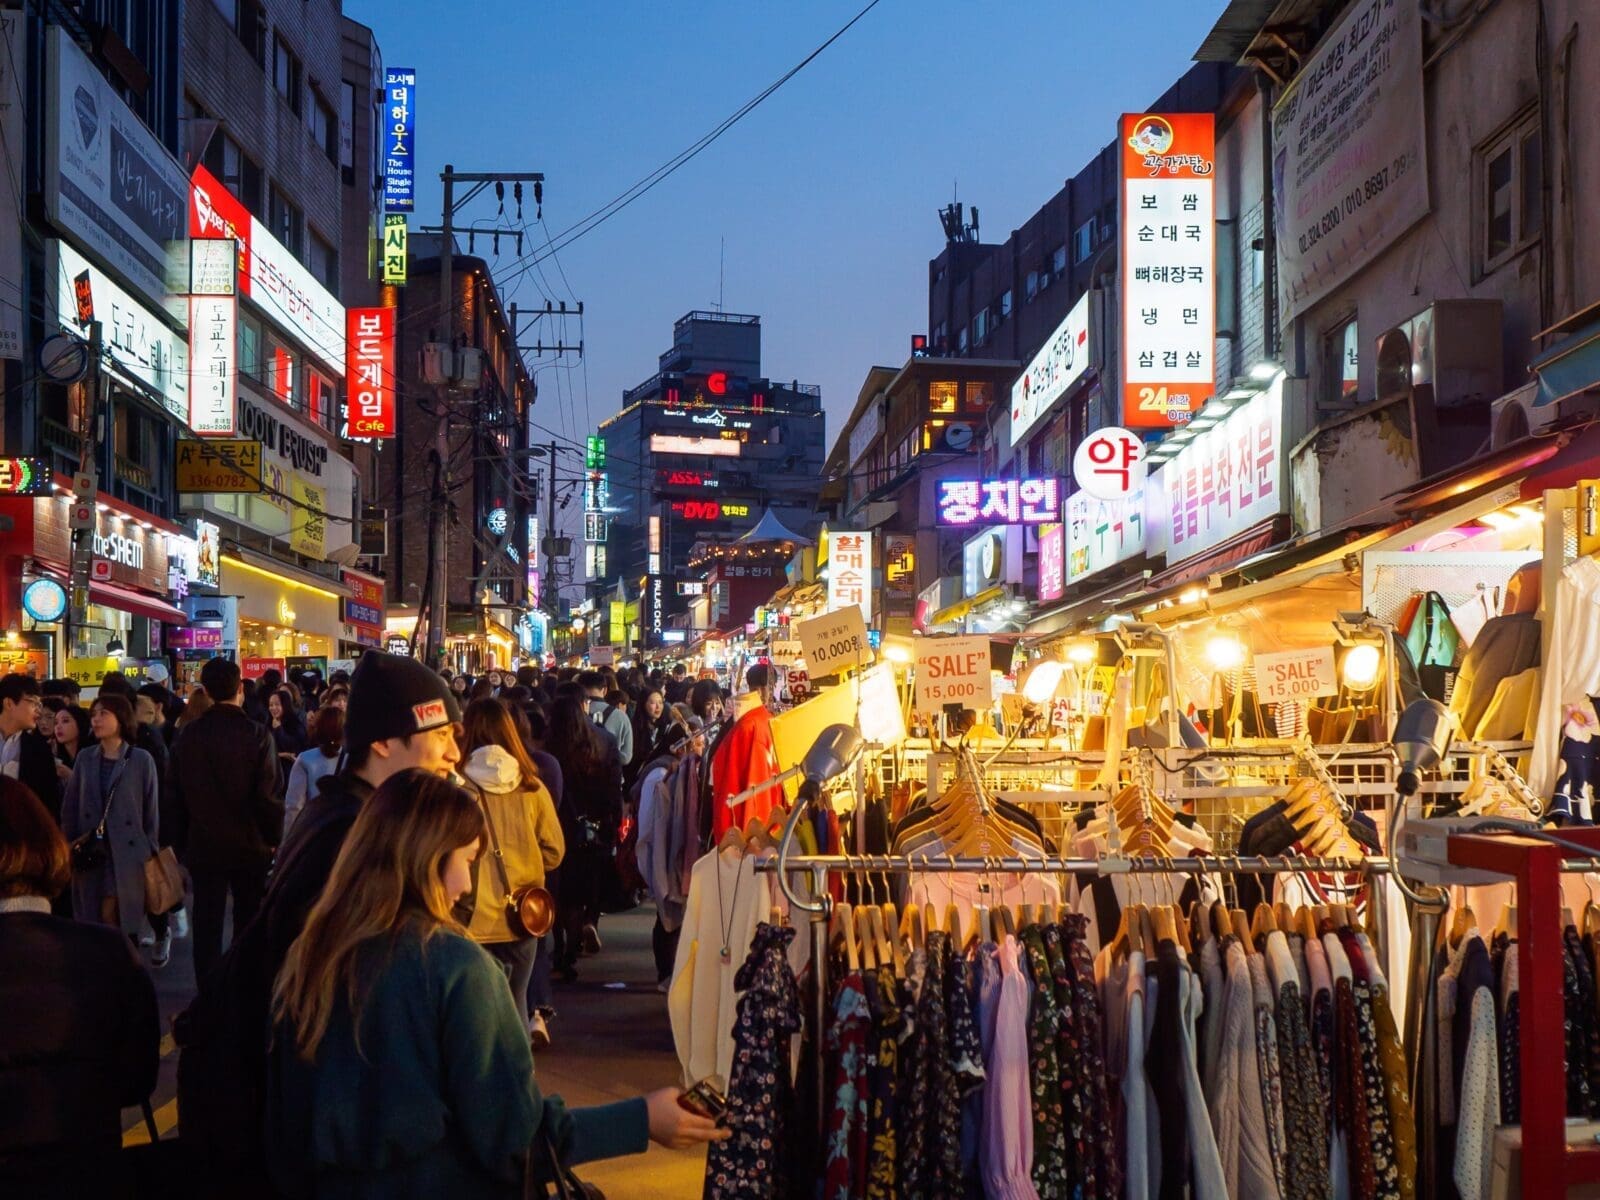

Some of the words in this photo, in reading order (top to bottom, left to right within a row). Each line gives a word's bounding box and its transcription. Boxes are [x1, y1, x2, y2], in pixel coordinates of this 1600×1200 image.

[387, 159, 403, 167] The
[387, 167, 412, 176] House
[387, 177, 412, 187] Single
[387, 186, 410, 194] Room
[1137, 225, 1202, 242] 순대국
[387, 229, 405, 276] 사진
[1136, 266, 1204, 283] 뼈해장국
[357, 315, 383, 417] 보드게임
[1139, 351, 1202, 368] 삼겹살
[1168, 409, 1192, 422] Ope
[356, 420, 384, 431] Cafe
[1088, 438, 1138, 491] 약
[669, 472, 702, 485] ASSA
[1172, 418, 1275, 544] 필름부착전문
[684, 501, 719, 519] DVD
[722, 505, 748, 516] 영화관
[835, 535, 864, 606] 할매순대
